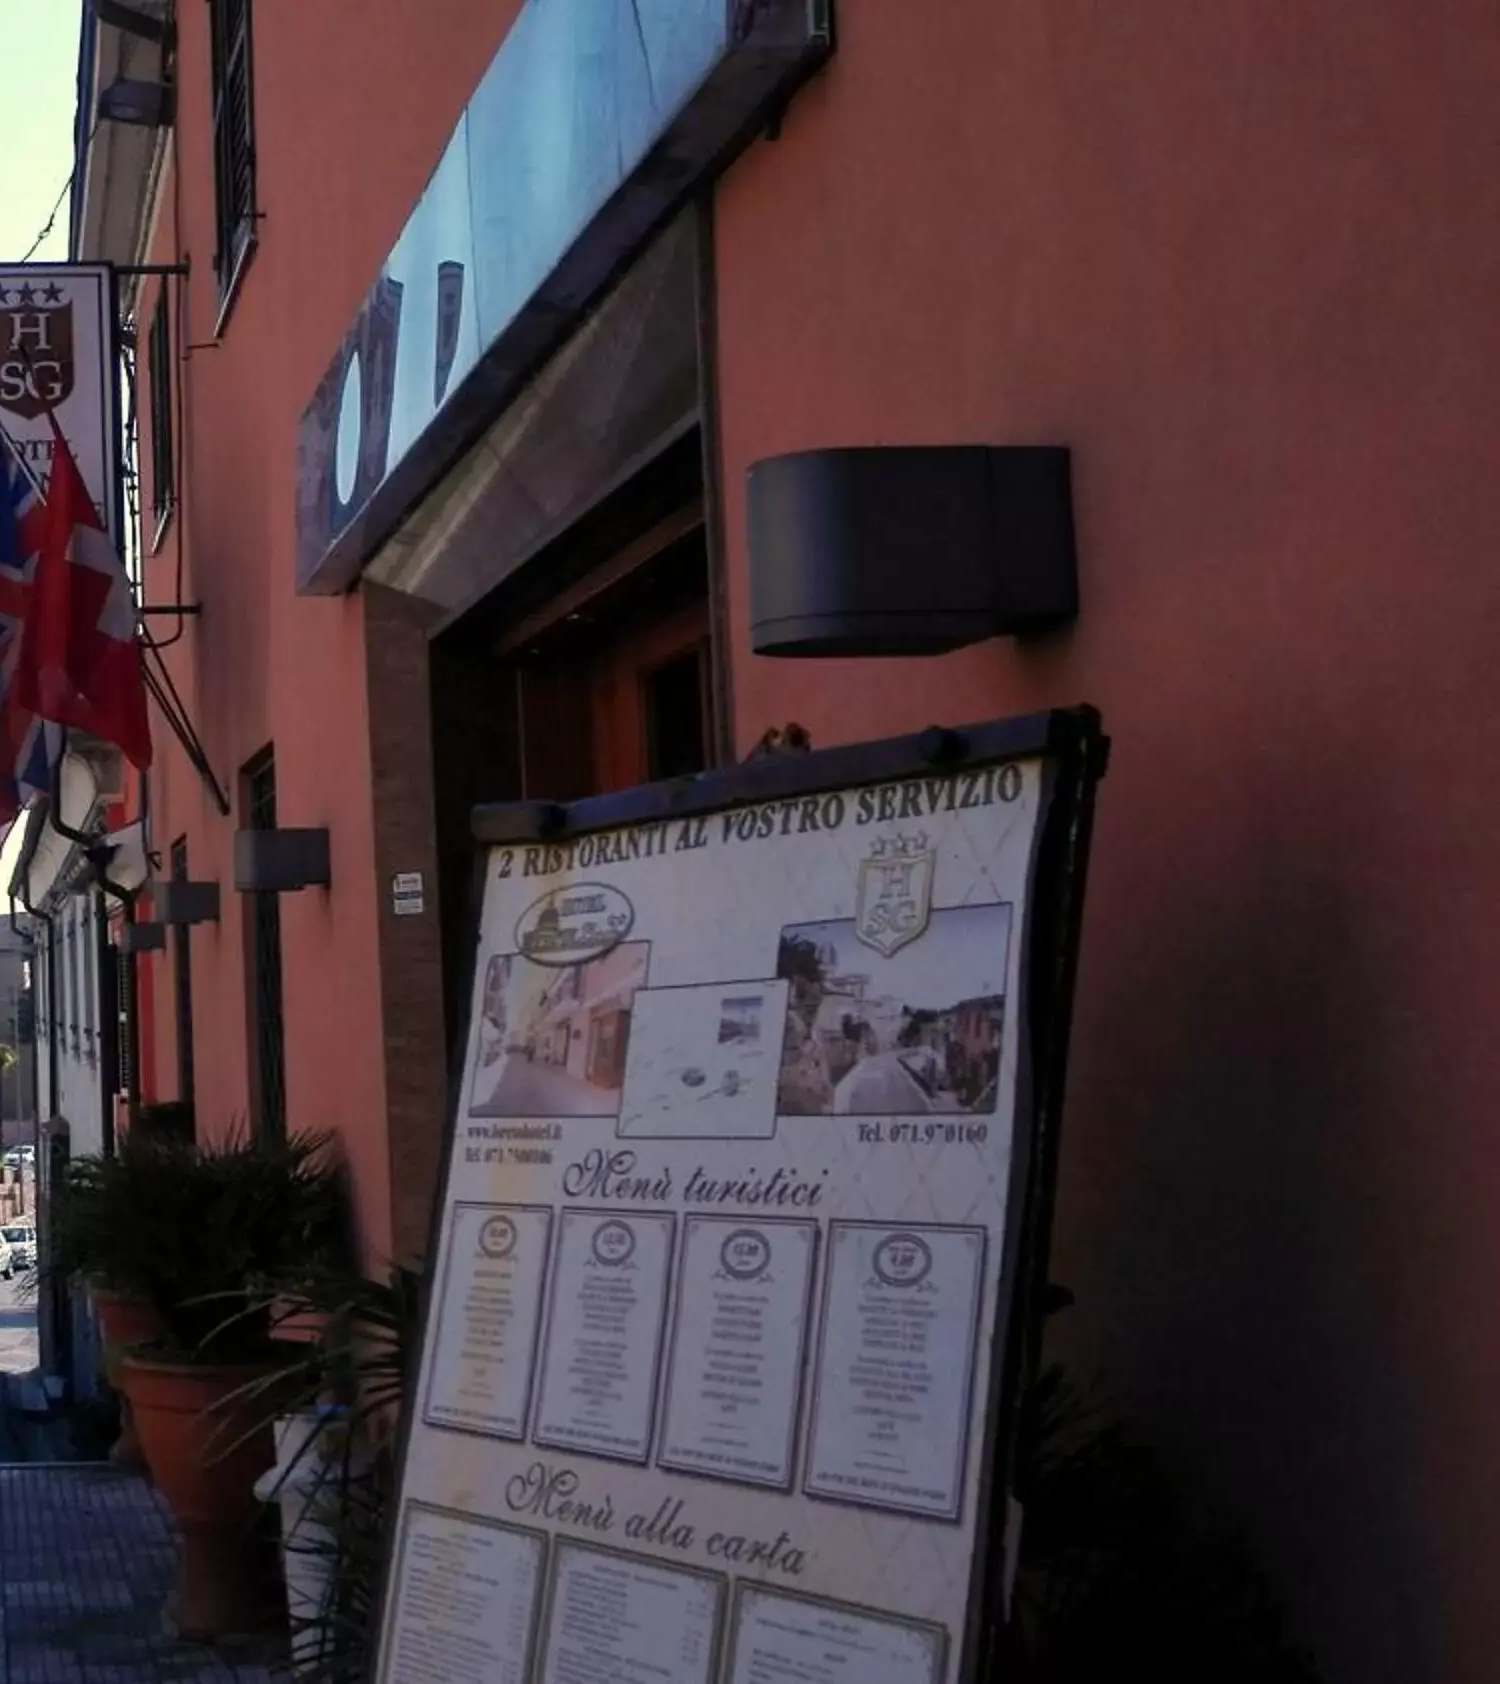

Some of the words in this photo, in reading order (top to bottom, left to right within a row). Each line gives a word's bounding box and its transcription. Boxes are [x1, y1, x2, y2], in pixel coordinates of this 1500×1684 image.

[9, 313, 51, 349] H
[0, 361, 62, 400] SG
[498, 850, 514, 878] 2
[522, 821, 668, 877] RISTORANTI
[675, 816, 708, 850] AL
[721, 794, 844, 841] VOSTRO
[856, 764, 1023, 826] SERVIZIO
[879, 863, 914, 899] H
[864, 901, 917, 936] SG
[858, 1121, 885, 1142] Tel.
[563, 1149, 671, 1201] Menù
[684, 1167, 829, 1206] turistici
[506, 1461, 616, 1531] Menù
[624, 1496, 695, 1549] alla
[705, 1531, 805, 1574] carta
